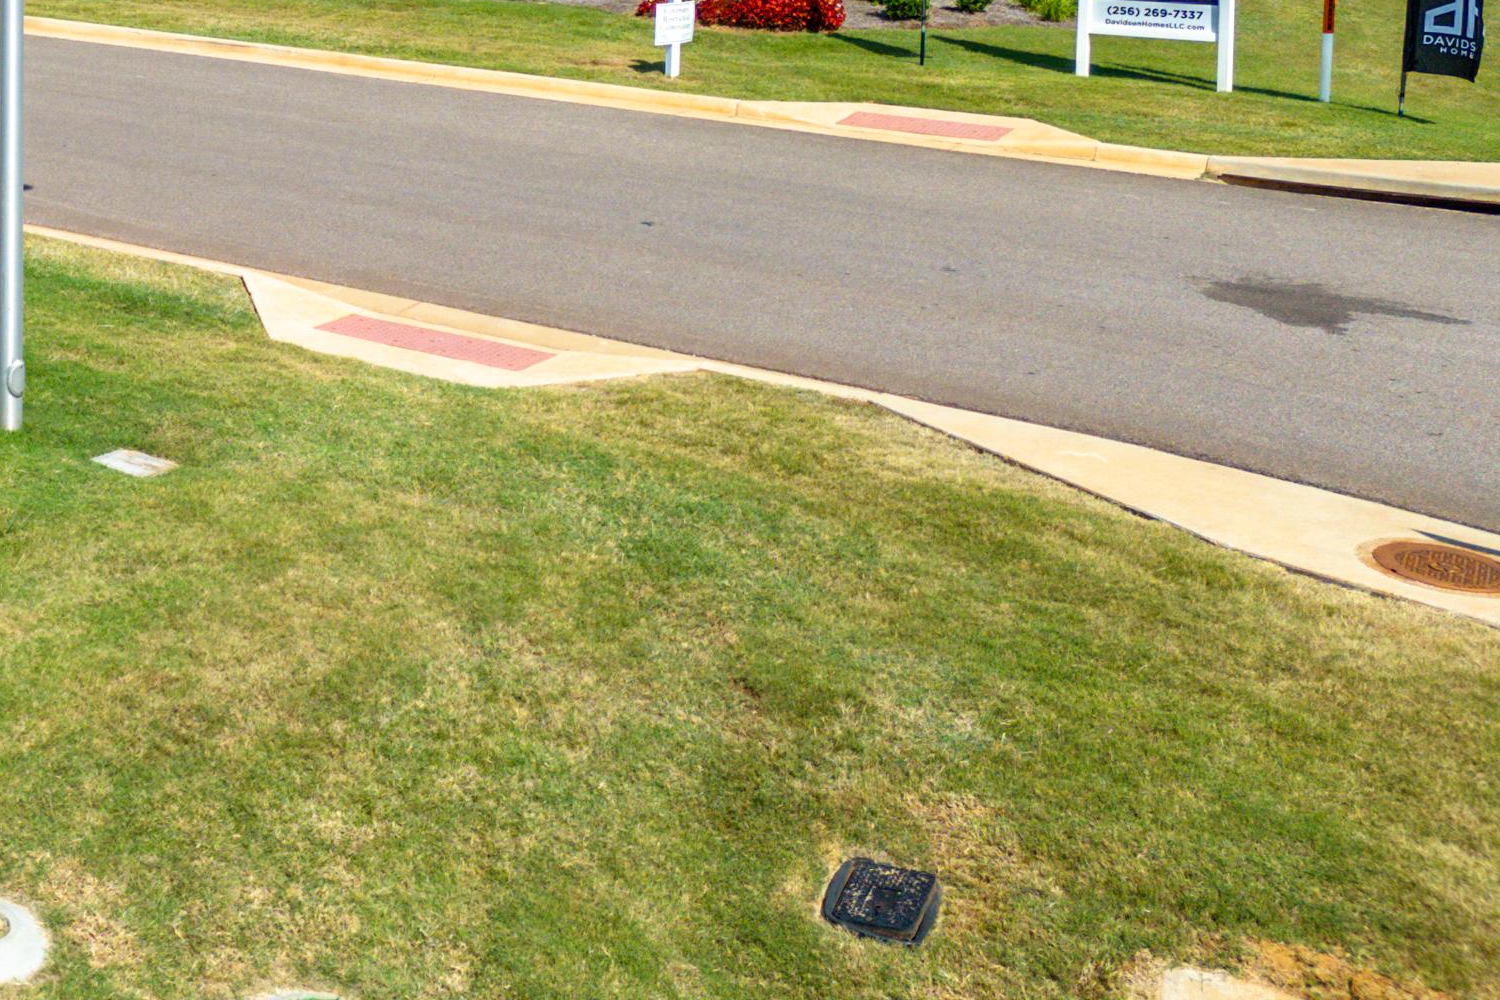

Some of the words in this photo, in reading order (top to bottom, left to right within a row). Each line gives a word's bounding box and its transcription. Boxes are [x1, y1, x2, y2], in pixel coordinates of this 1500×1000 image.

[1107, 5, 1140, 17] (256)
[1144, 7, 1203, 20] 269-7337
[1423, 35, 1476, 52] DAVIDS
[1440, 47, 1475, 59] HOME
